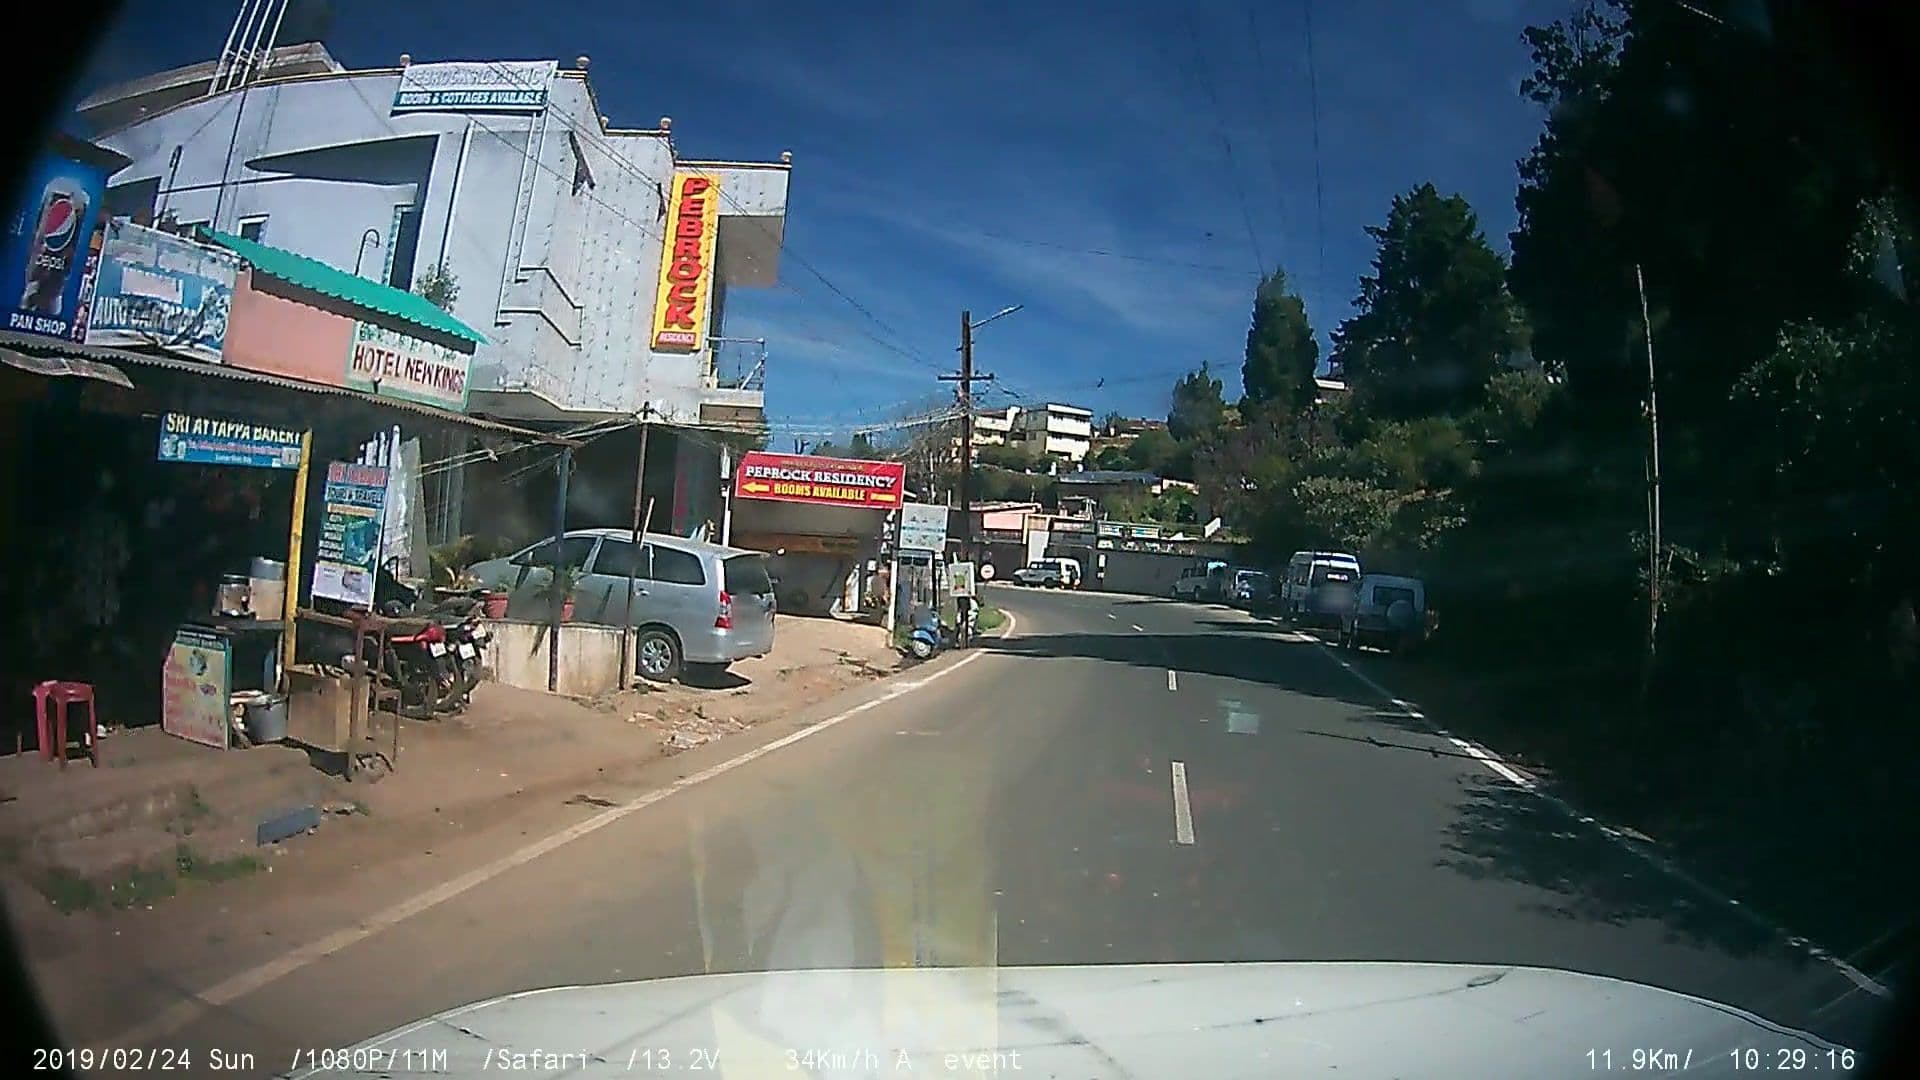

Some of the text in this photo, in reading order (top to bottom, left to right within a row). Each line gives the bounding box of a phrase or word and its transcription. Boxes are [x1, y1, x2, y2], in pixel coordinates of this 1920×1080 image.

[400, 93, 433, 105] ROOMS
[441, 92, 490, 104] COTTAGES
[490, 92, 543, 104] AVAILABLE
[664, 177, 710, 329] PEBROCK
[92, 296, 128, 326] AUTO
[9, 312, 67, 336] PAN SHOP
[352, 344, 466, 395] HOTEL NEW KINGS
[167, 412, 190, 433] SRI
[813, 470, 897, 488] RESIDENCY
[773, 482, 866, 501] ROOMS AVAILABLE
